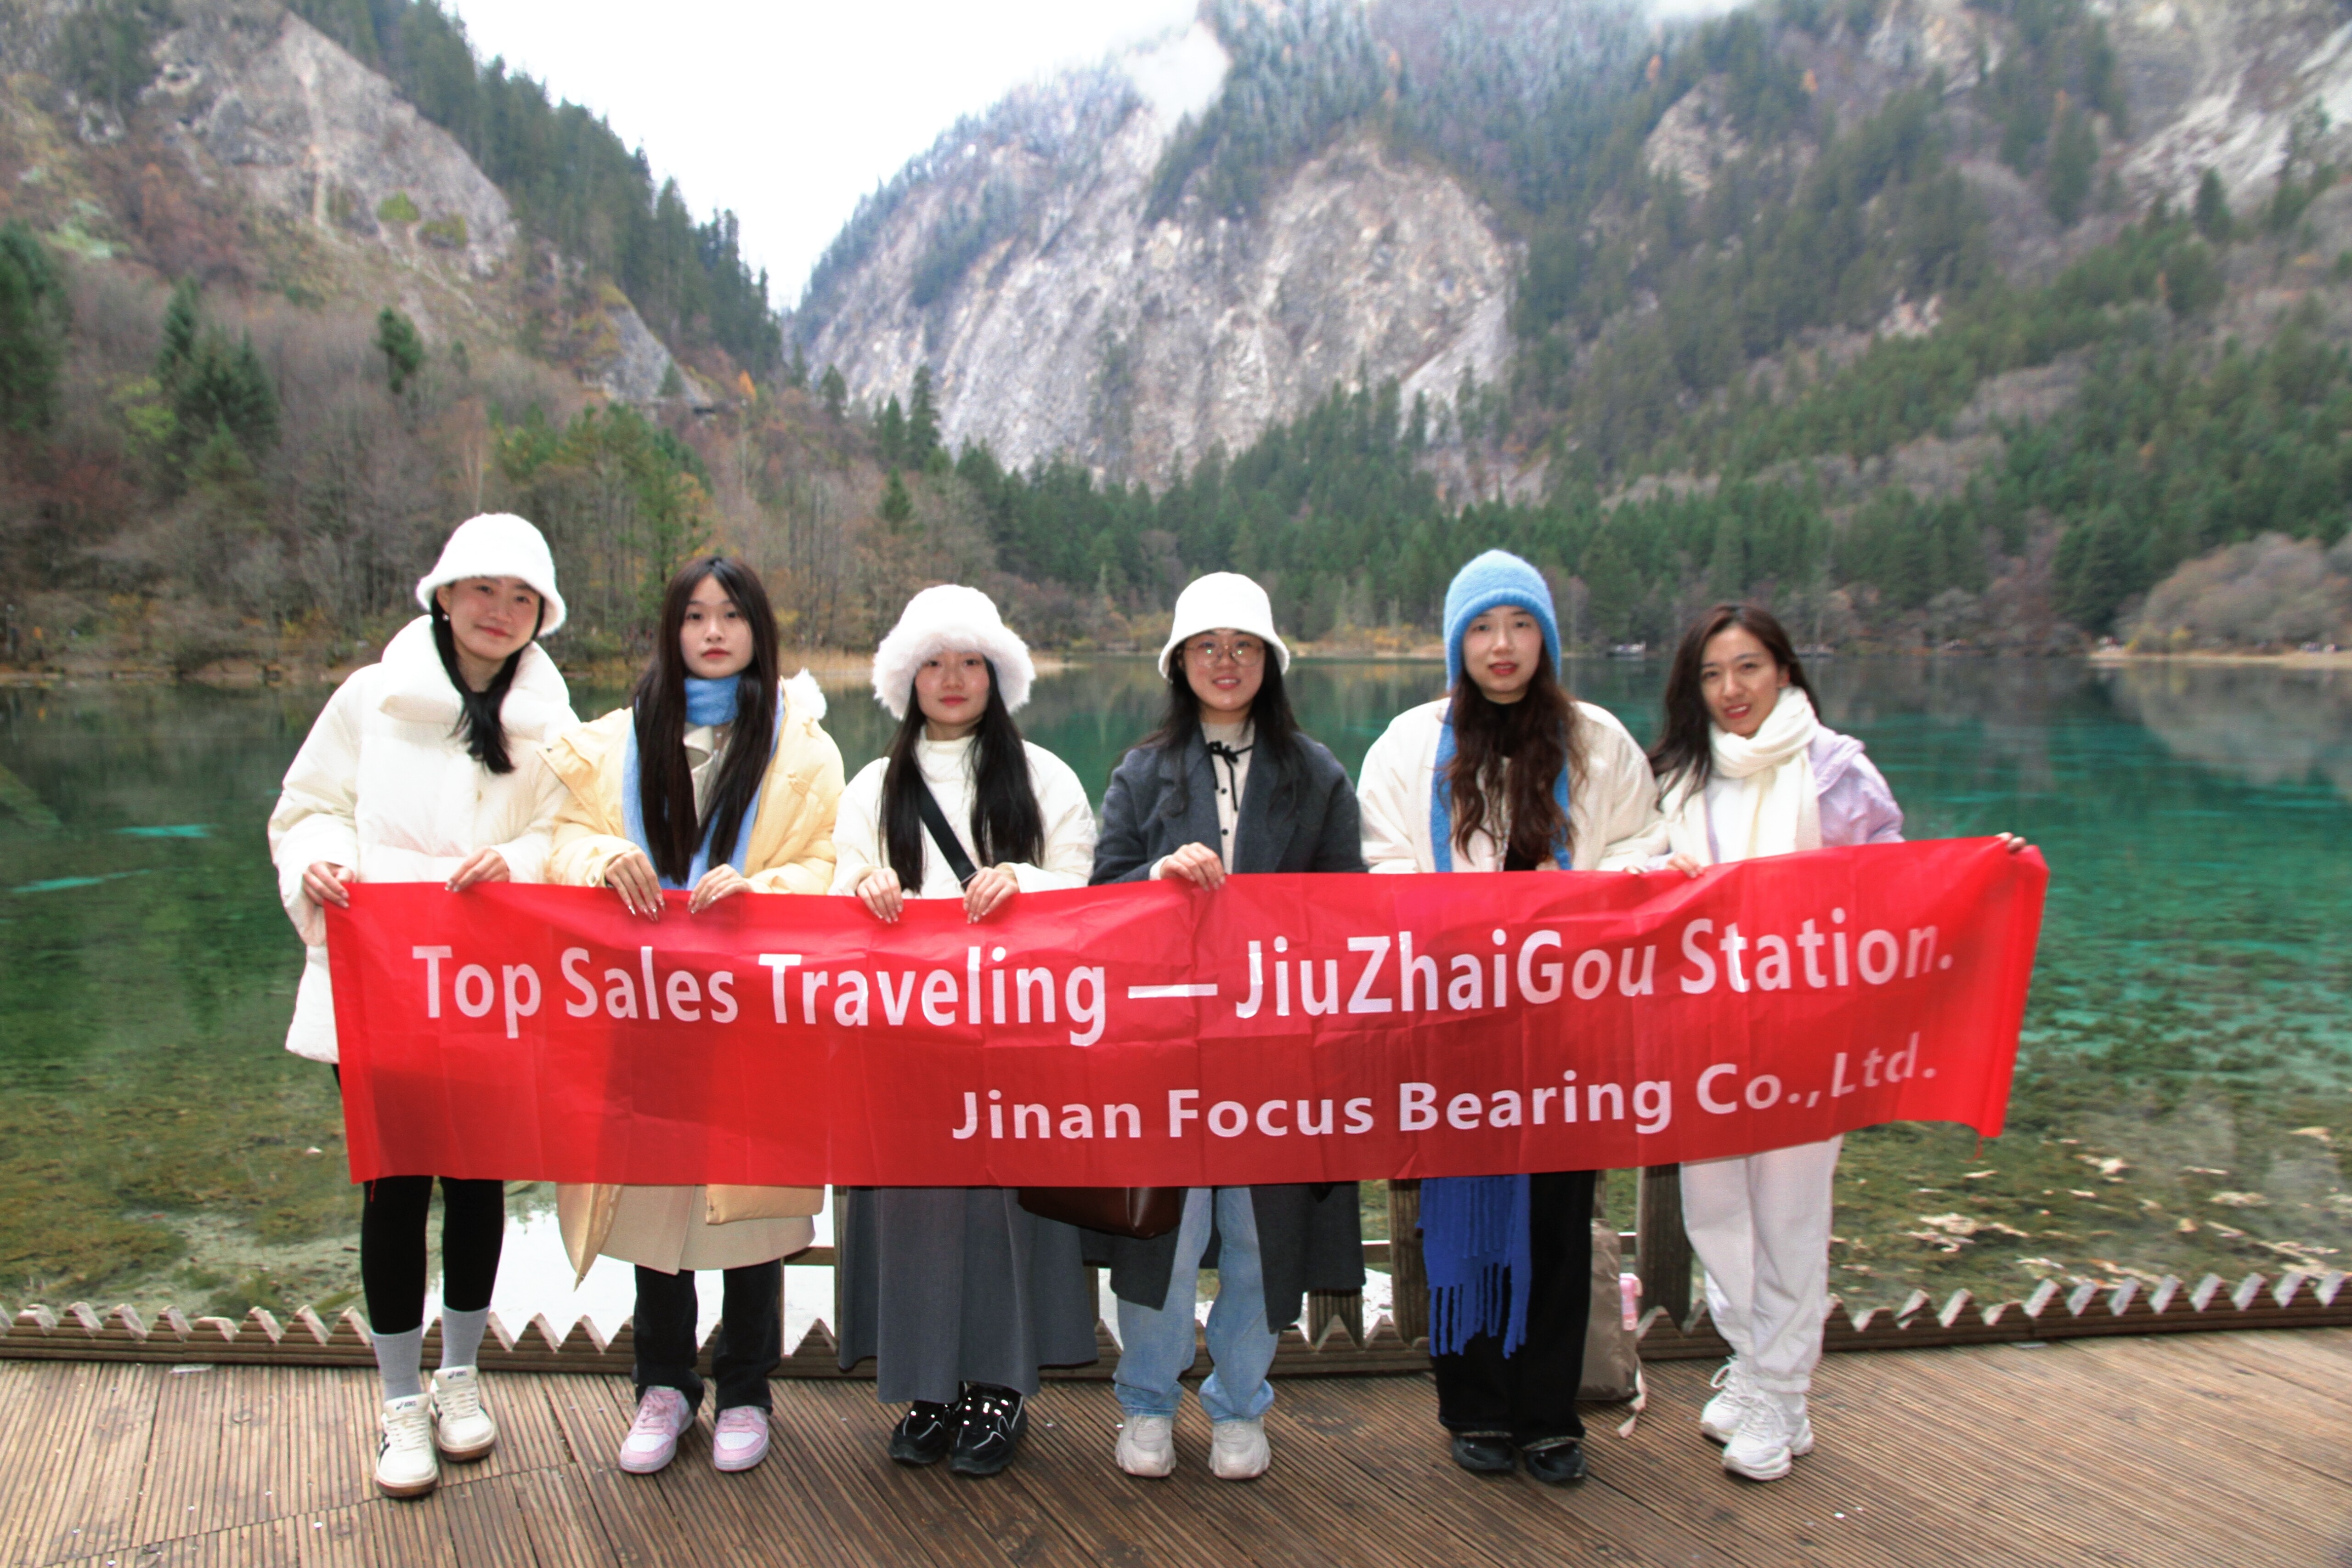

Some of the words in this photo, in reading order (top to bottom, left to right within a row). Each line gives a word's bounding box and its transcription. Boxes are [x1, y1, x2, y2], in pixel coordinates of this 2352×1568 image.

[413, 946, 541, 1038] Top
[561, 945, 738, 1023] Sales
[758, 945, 1106, 1047] Traveling
[1236, 928, 1657, 1019] JiuZhaiGou
[1680, 907, 1953, 994] Station.
[952, 1089, 1140, 1139] Jinan
[1168, 1089, 1374, 1138] Focus
[1399, 1070, 1672, 1133] Bearing
